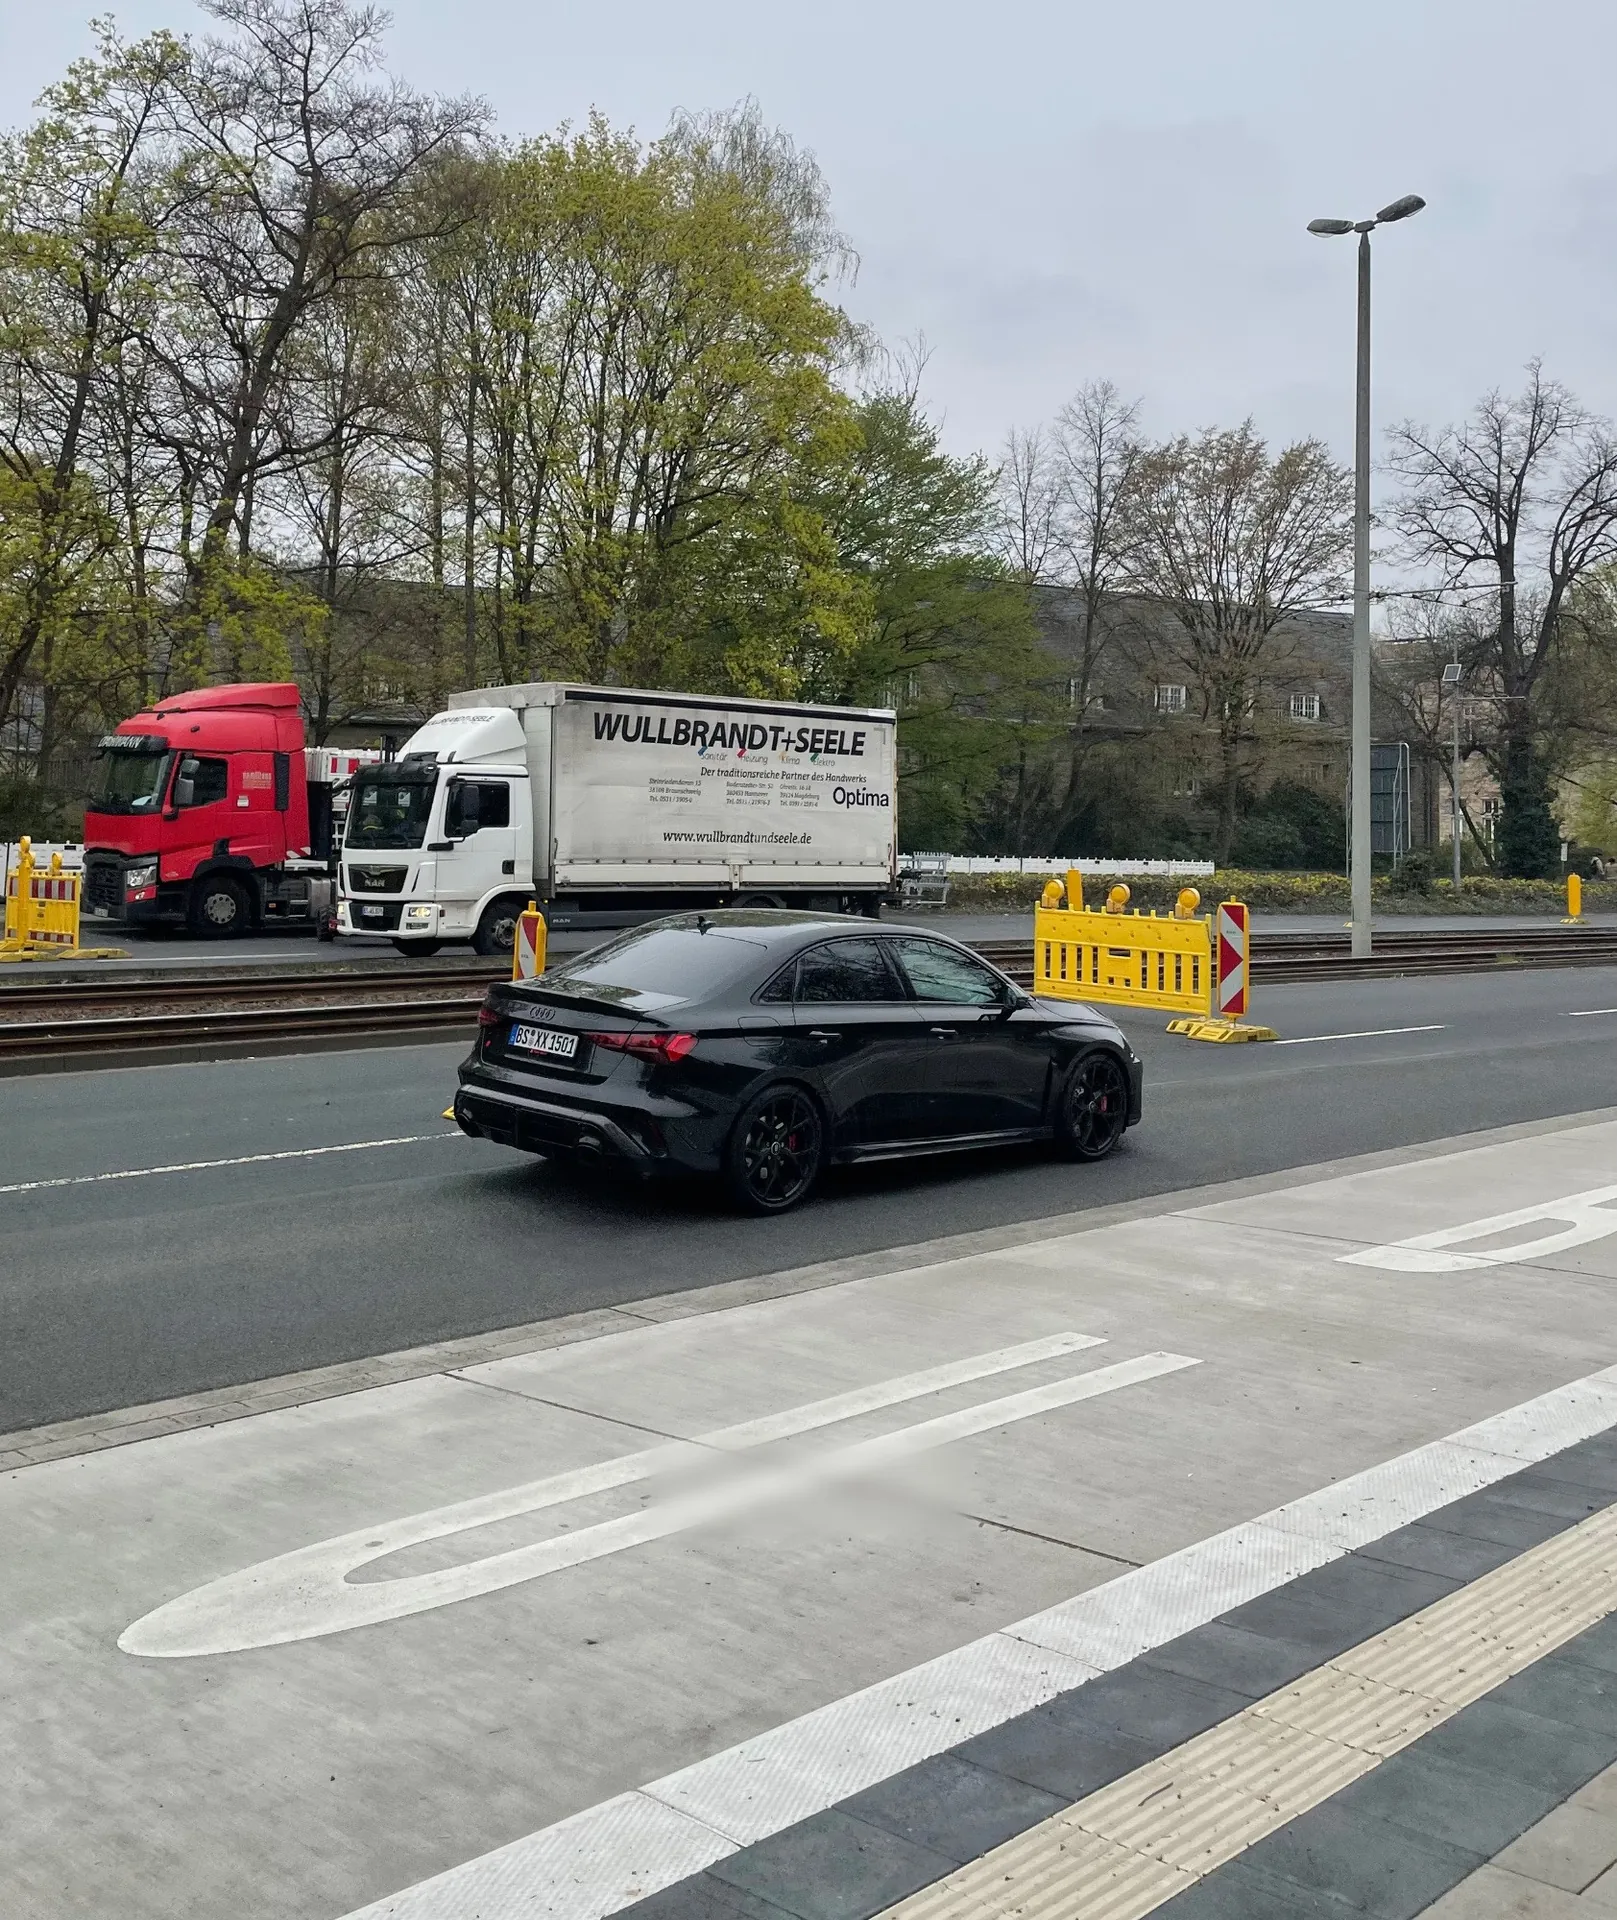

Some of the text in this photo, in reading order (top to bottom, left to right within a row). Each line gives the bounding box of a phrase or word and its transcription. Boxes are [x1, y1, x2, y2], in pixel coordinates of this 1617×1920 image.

[593, 711, 867, 757] WULLBRANDT+SEELE
[740, 754, 769, 766] Heizung
[781, 755, 801, 766] Klima
[700, 766, 867, 783] Der traditionsreiche Partner des Handwerks
[832, 786, 889, 808] Optima
[663, 830, 812, 845] www.wullbrandtundseele.de
[516, 1027, 530, 1045] BS
[534, 1031, 550, 1049] XX
[548, 1034, 575, 1055] 1501
